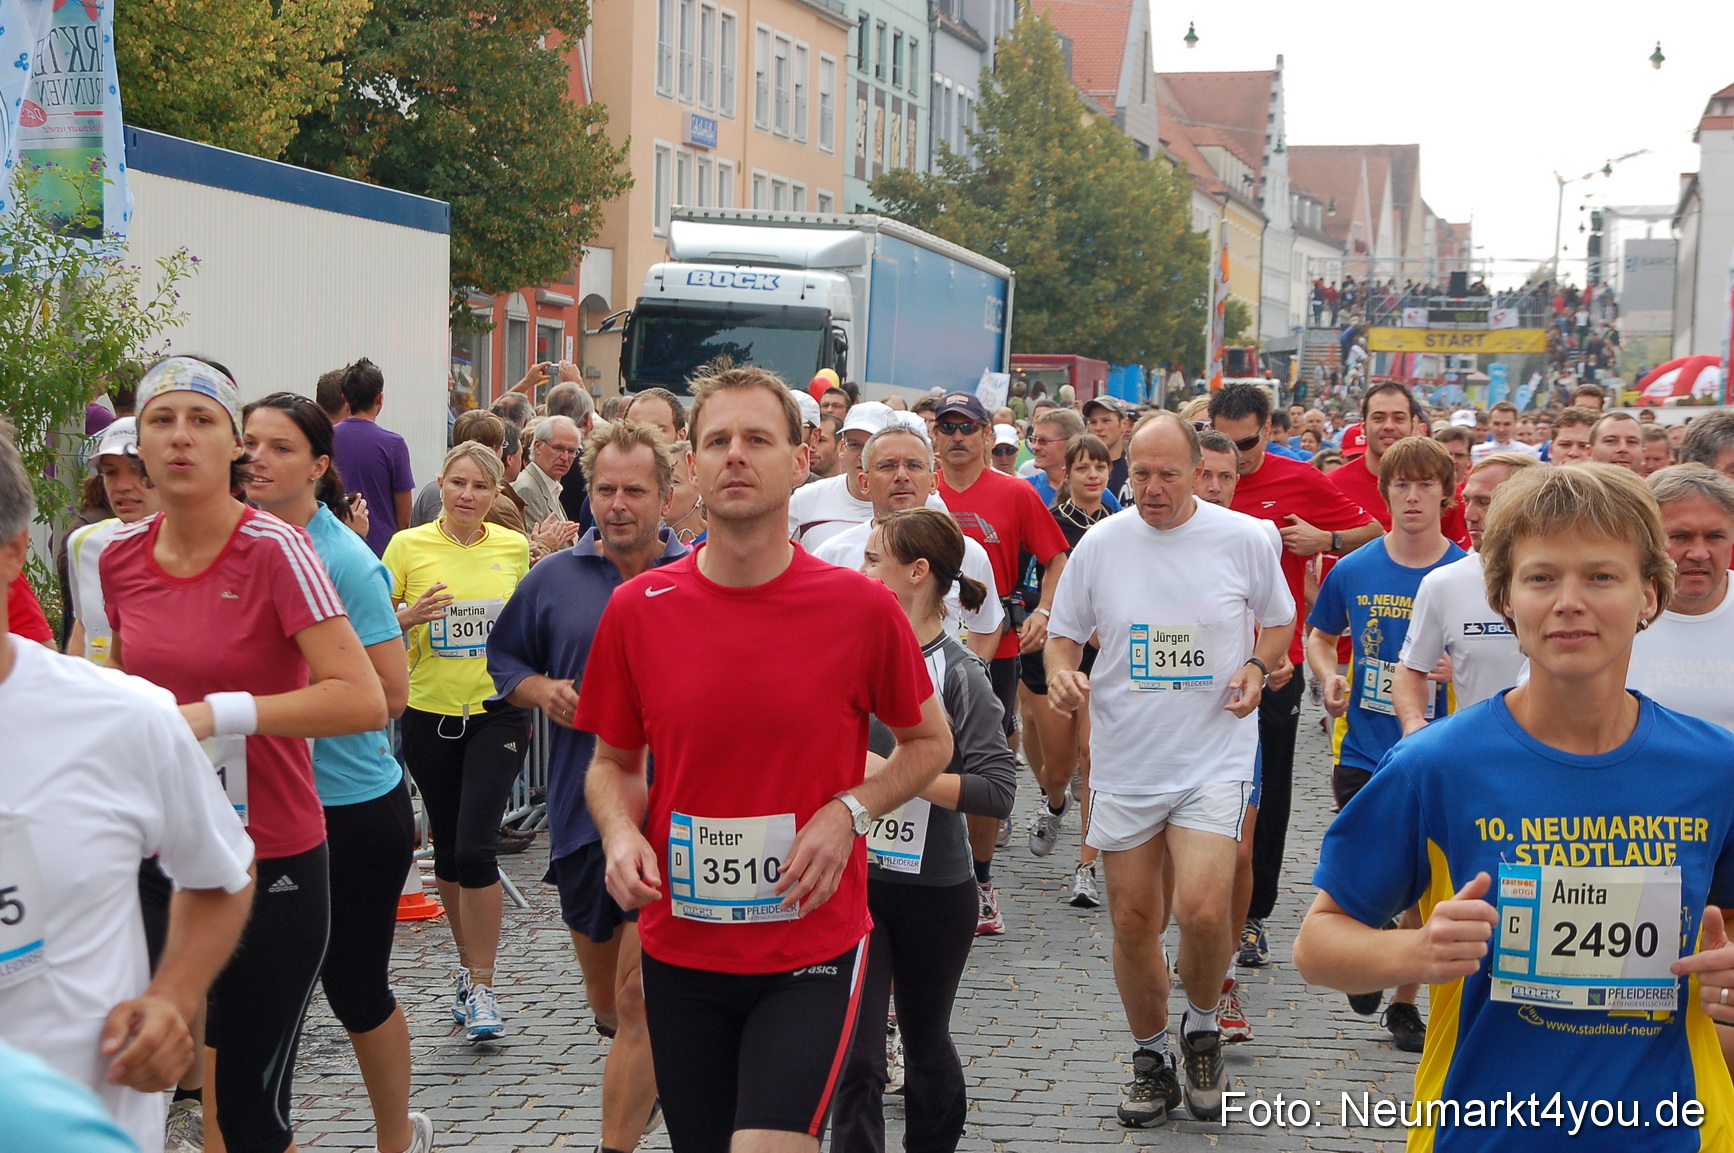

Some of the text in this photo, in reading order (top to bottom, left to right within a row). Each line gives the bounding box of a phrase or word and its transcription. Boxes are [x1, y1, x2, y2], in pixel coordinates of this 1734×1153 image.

[687, 270, 780, 290] BOCK
[1425, 333, 1487, 347] START
[1357, 595, 1371, 605] 10.
[450, 606, 485, 617] Martina
[434, 623, 439, 631] C
[1153, 630, 1190, 645] Jürgen
[1136, 648, 1141, 658] C
[1155, 650, 1205, 668] 3146
[699, 826, 743, 846] Peter
[866, 818, 915, 843] 795
[1475, 816, 1709, 842] 10. NEUMARKTER
[675, 852, 682, 866] D
[1515, 842, 1677, 866] STADTLAUF
[702, 857, 781, 885] 3510
[1552, 879, 1607, 904] Anita
[1509, 916, 1520, 934] C
[1551, 921, 1659, 958] 2490
[807, 965, 838, 975] asics
[1511, 985, 1561, 999] BOCK
[1608, 988, 1675, 1000] PFLEIDERER
